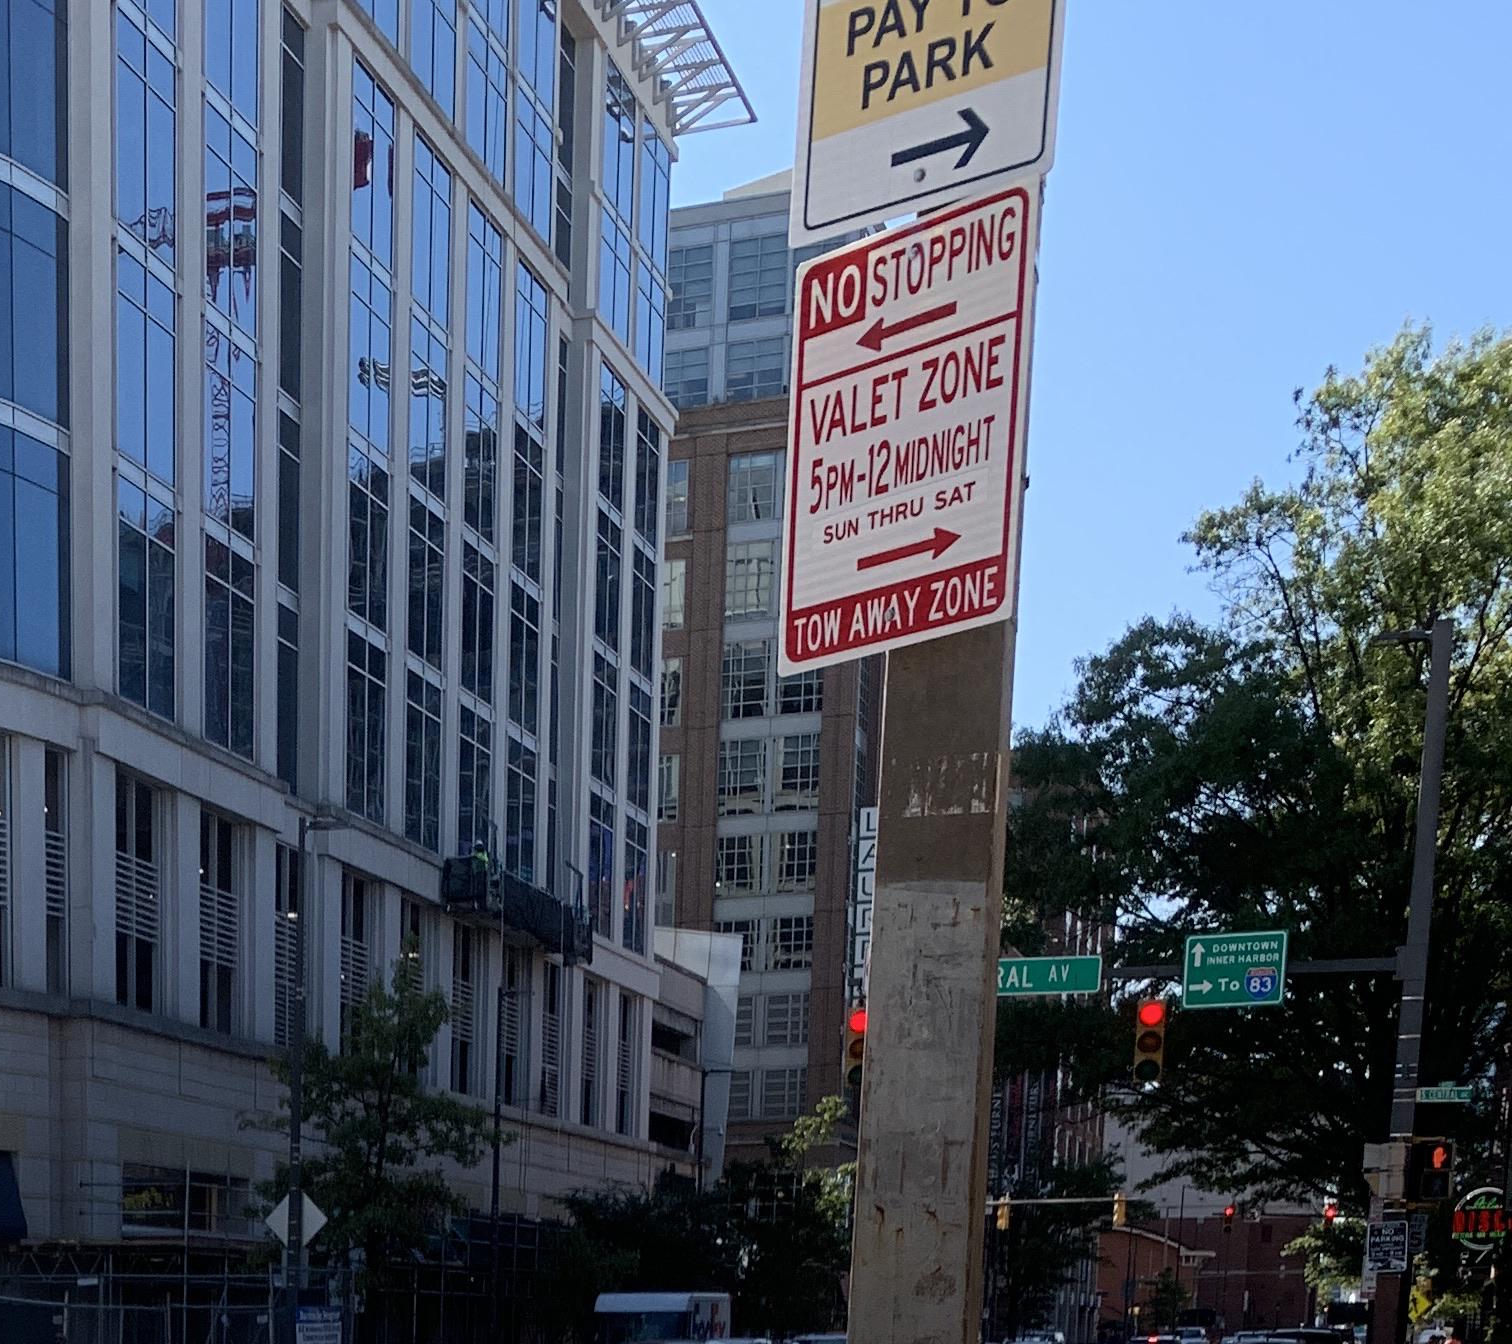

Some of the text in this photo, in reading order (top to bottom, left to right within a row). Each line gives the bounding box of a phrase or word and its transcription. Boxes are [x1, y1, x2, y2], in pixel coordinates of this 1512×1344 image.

[846, 0, 929, 56] PAY
[861, 20, 996, 110] PARK
[809, 206, 1017, 330] NO STOPPING
[810, 334, 1006, 446] VALET ZONE
[823, 481, 976, 544] SUN THRU SAT
[793, 566, 999, 656] TOW AWAY ZONE
[1048, 964, 1070, 982] AV
[1207, 953, 1280, 966] INNER HARBOR
[1212, 941, 1279, 953] DOWNTOWN
[1218, 977, 1272, 993] To 83
